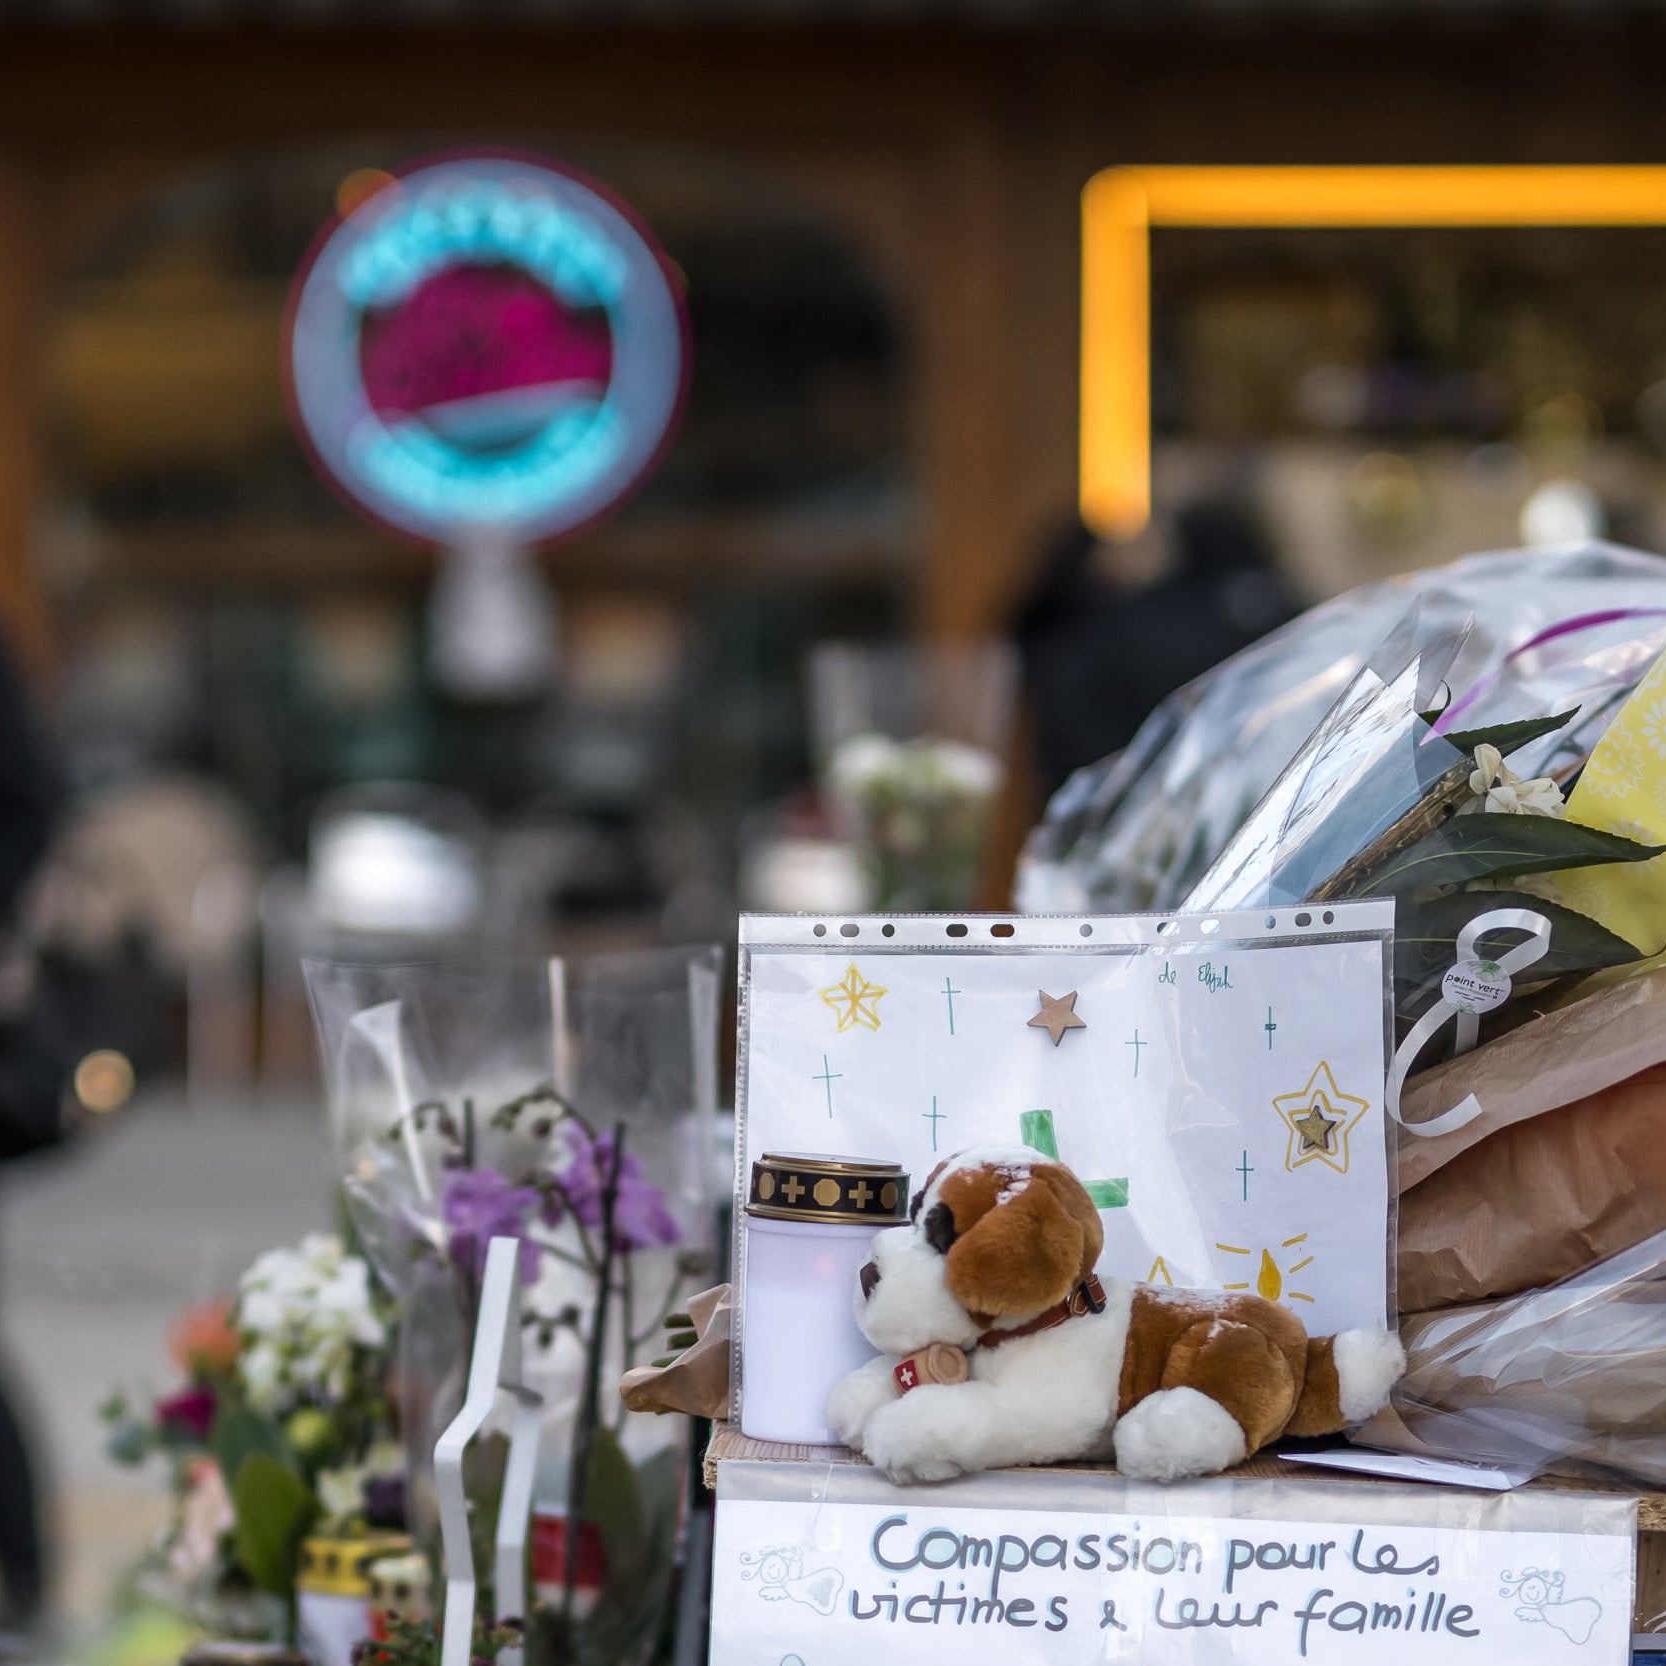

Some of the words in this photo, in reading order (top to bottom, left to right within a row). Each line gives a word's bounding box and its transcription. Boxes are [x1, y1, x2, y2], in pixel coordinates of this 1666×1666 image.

[1158, 961, 1177, 985] de
[1445, 974, 1476, 988] point
[869, 1512, 1203, 1606] Compassion
[1223, 1532, 1335, 1595] pour
[848, 1579, 1069, 1632] victimes
[1293, 1587, 1481, 1658] famille
